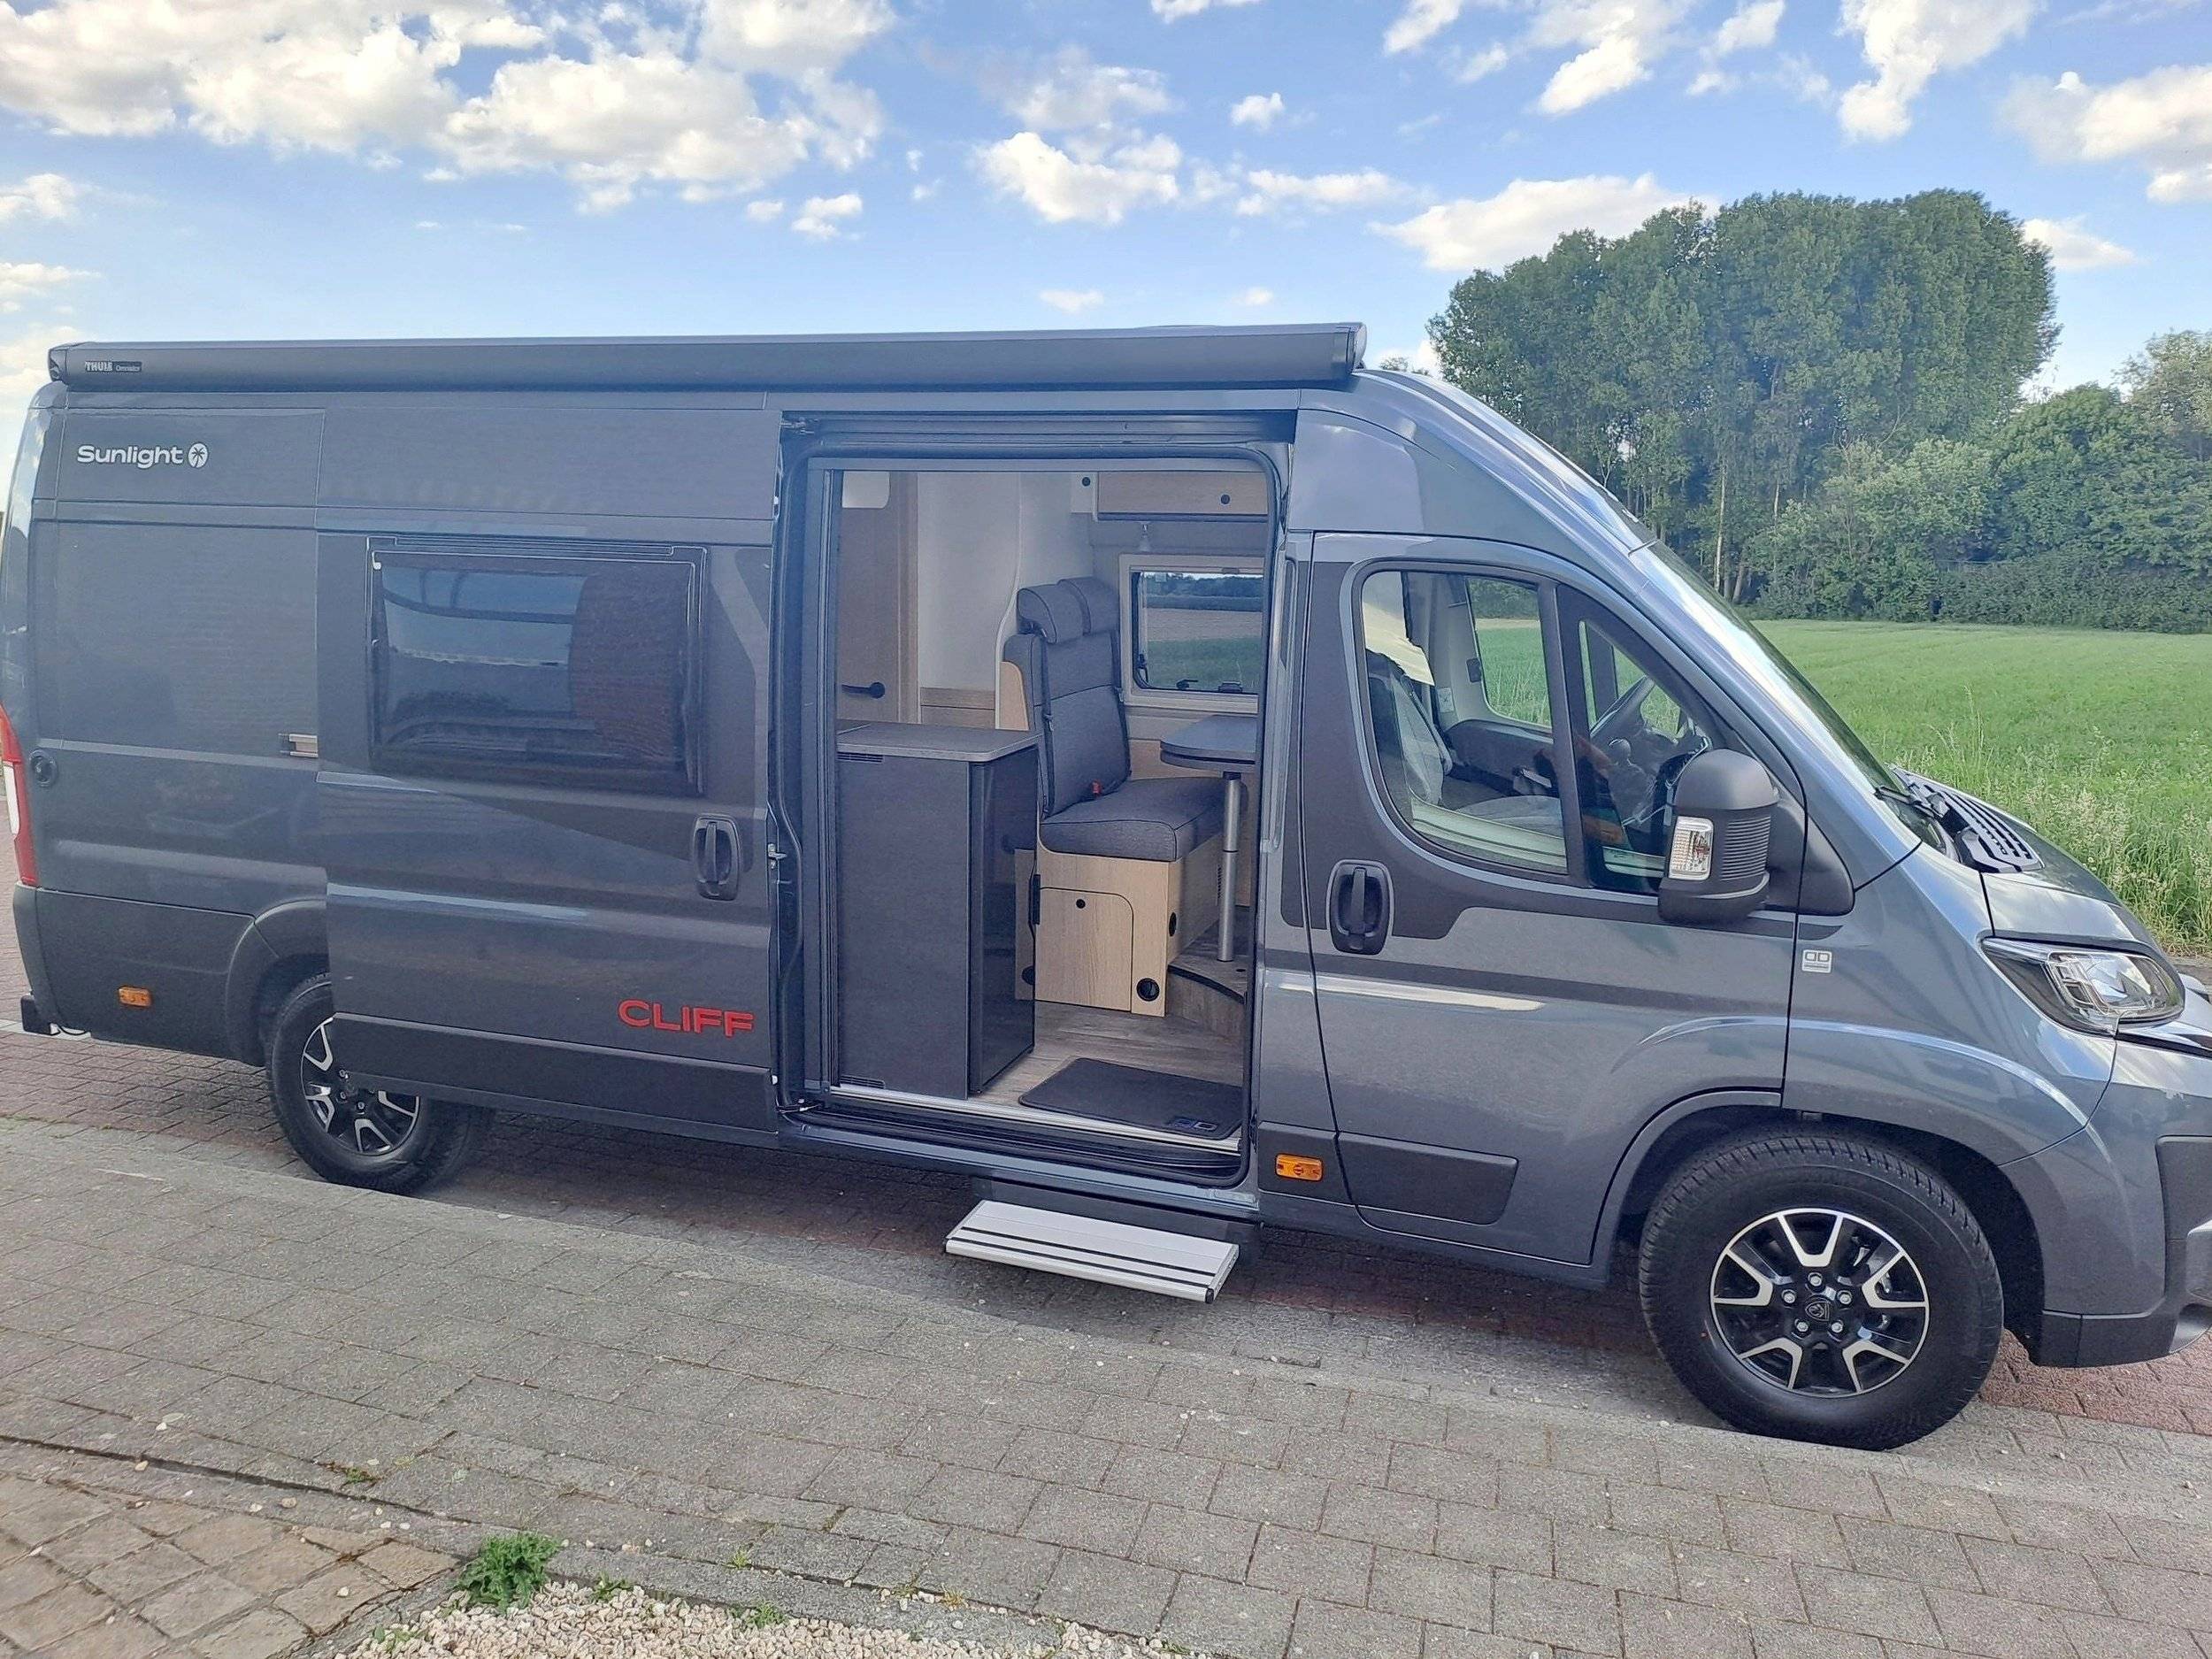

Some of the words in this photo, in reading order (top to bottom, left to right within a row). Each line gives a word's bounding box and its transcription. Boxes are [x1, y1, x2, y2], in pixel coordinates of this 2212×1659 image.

[85, 361, 113, 372] THULE
[77, 444, 184, 469] Sunlight
[618, 999, 755, 1038] CLIFF
